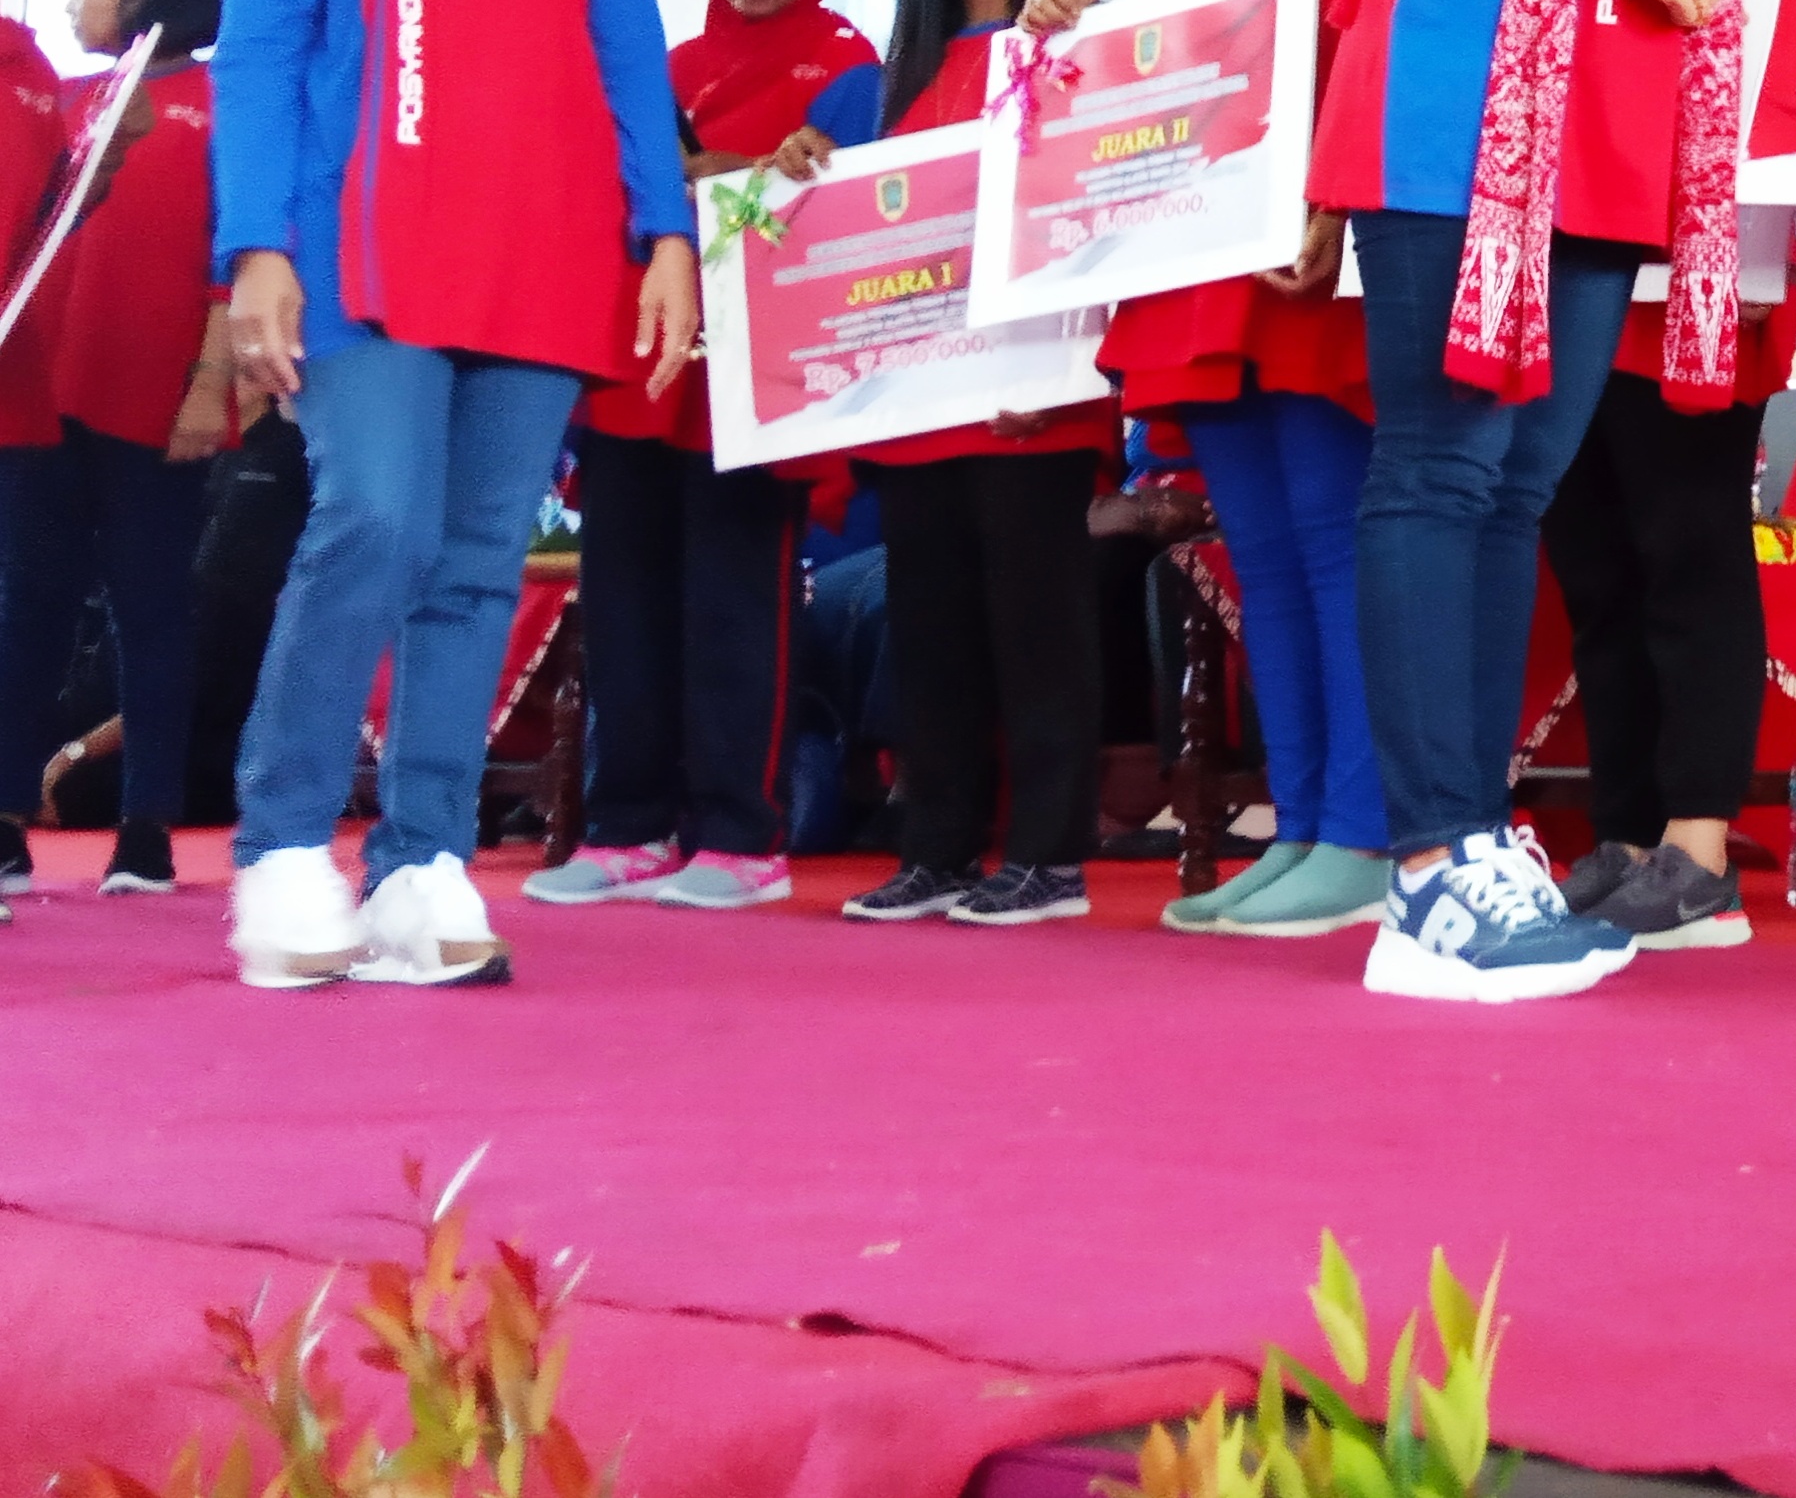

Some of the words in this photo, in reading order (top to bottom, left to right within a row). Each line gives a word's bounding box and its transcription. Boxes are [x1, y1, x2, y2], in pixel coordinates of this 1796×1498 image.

[1090, 123, 1166, 163] JUARA
[846, 267, 935, 306] JUARA
[940, 260, 953, 286] I
